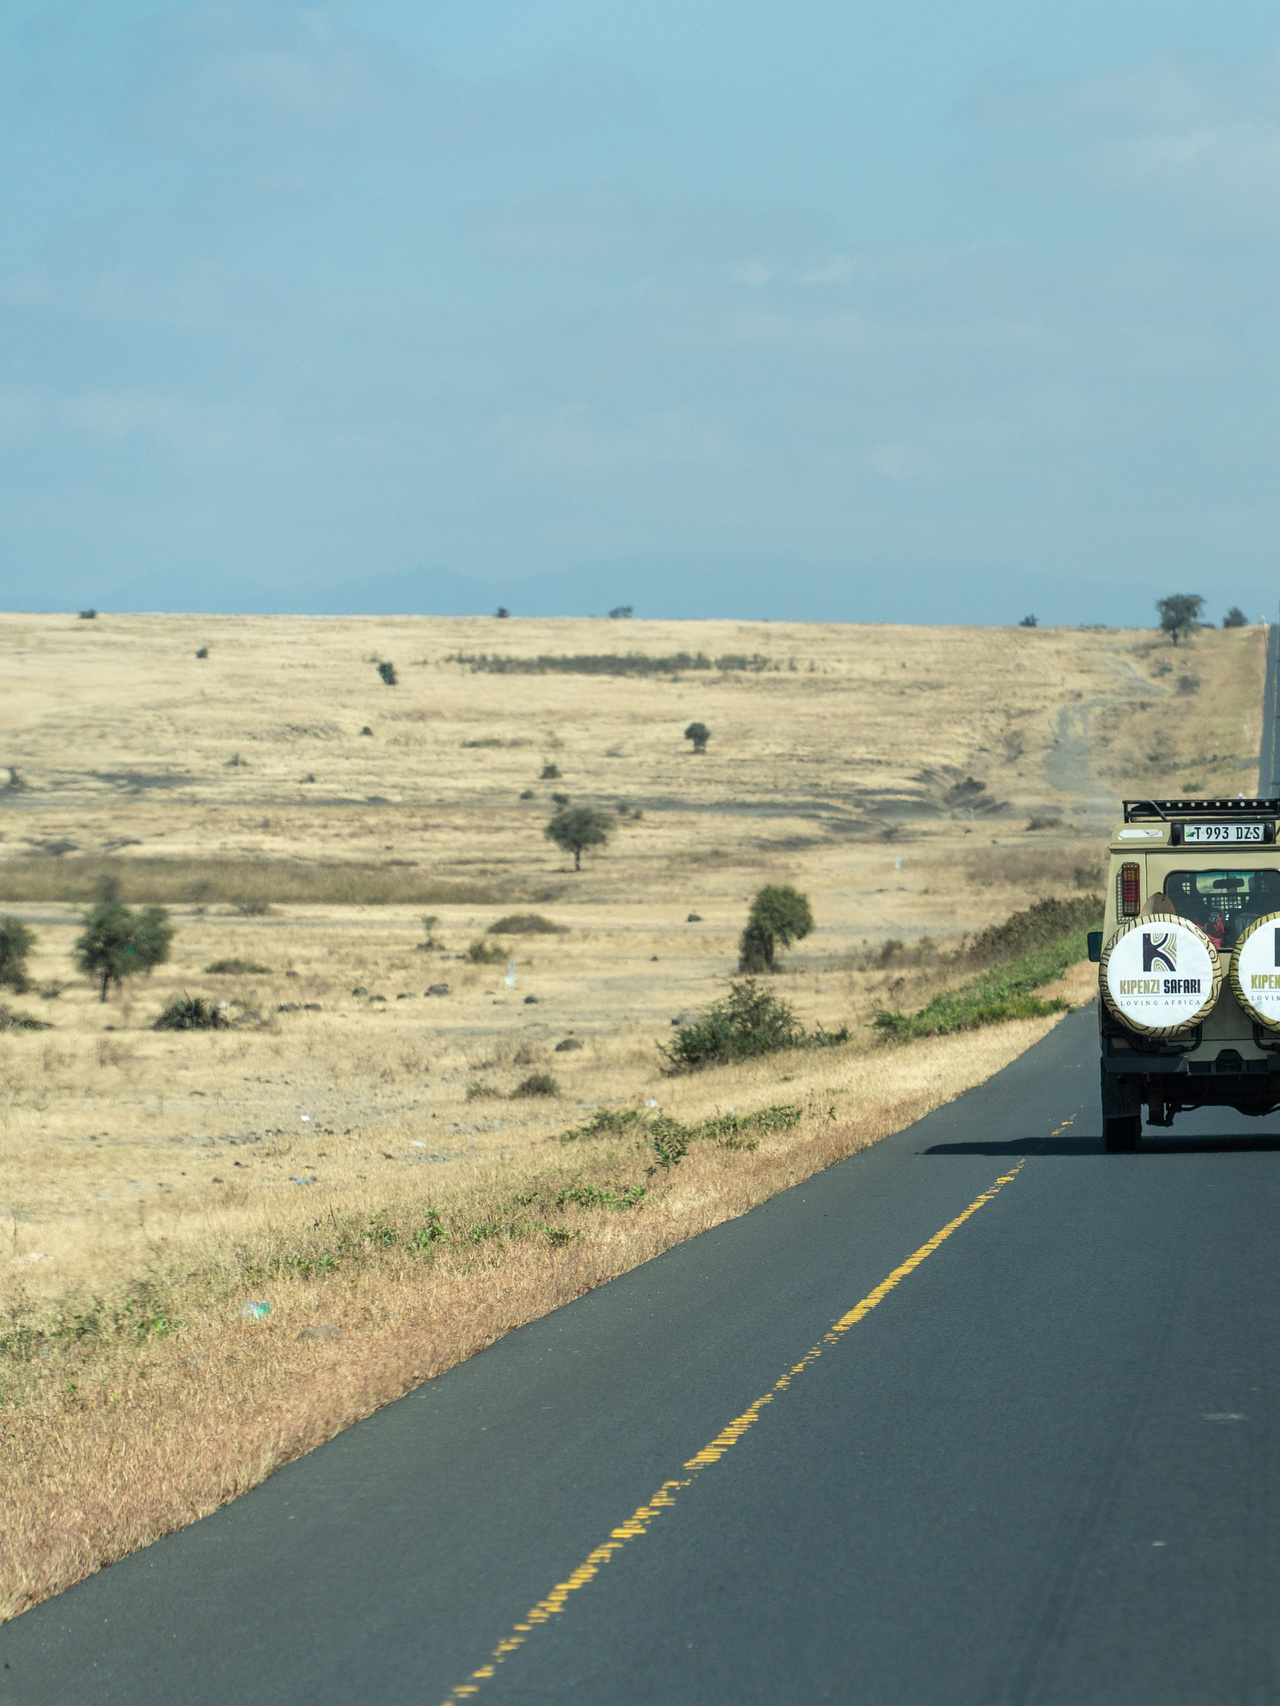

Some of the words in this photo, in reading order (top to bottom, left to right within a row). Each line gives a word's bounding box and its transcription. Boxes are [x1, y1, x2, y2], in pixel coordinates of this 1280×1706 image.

[1194, 827, 1201, 839] T
[1206, 827, 1229, 839] 993
[1236, 827, 1260, 839] DZS
[1119, 979, 1160, 995] KIPENZI
[1163, 978, 1201, 994] SAFARI
